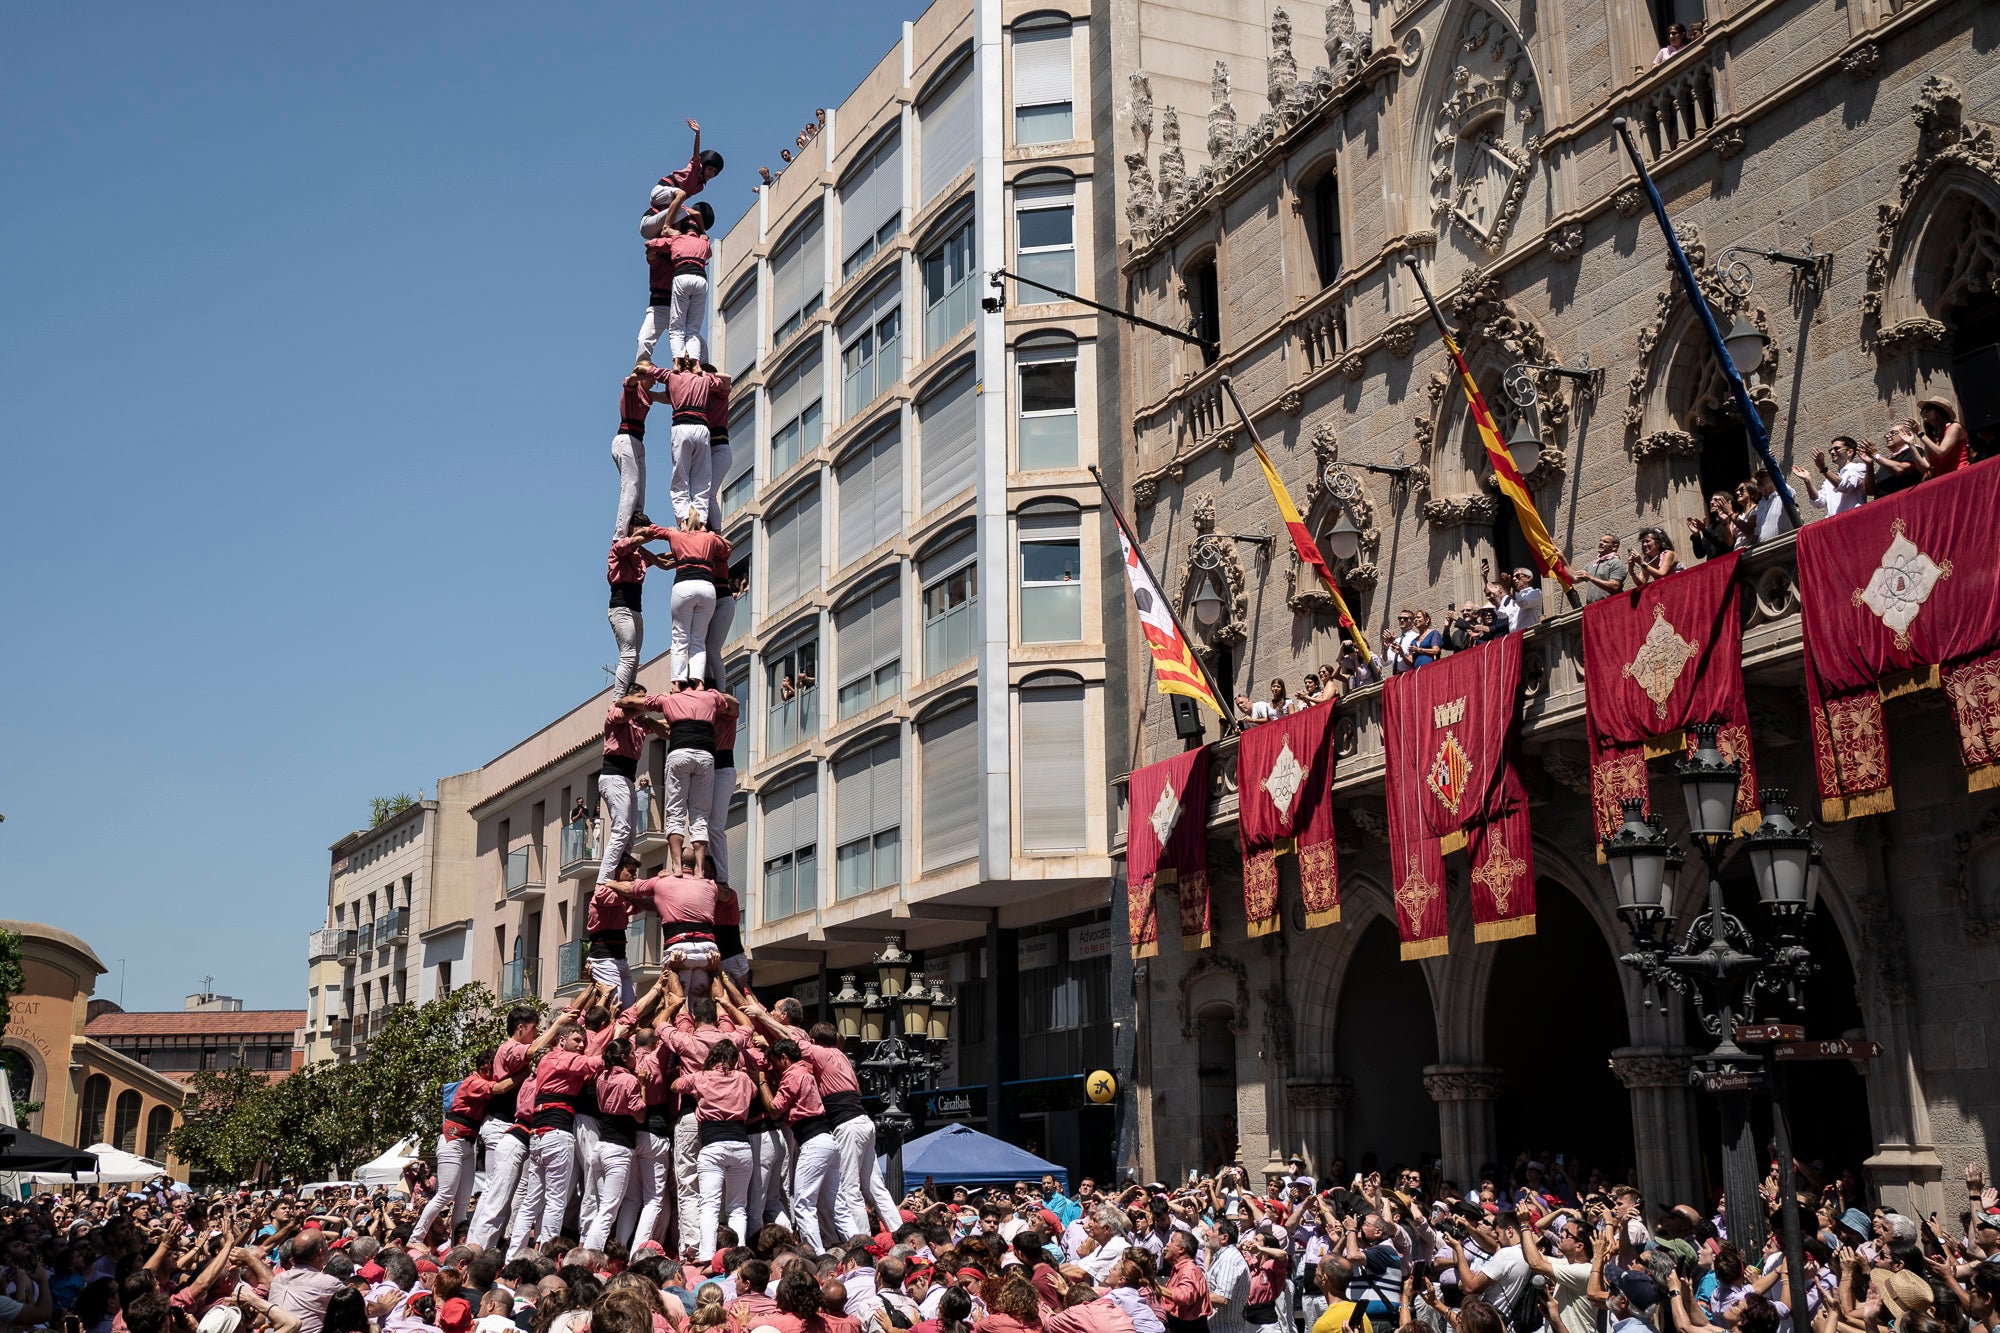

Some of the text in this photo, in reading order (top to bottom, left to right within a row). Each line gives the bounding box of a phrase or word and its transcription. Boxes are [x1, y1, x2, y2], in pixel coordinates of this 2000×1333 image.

[1079, 928, 1111, 944] Advocats
[8, 1000, 41, 1015] RCAT
[938, 1094, 971, 1111] CaixaBank
